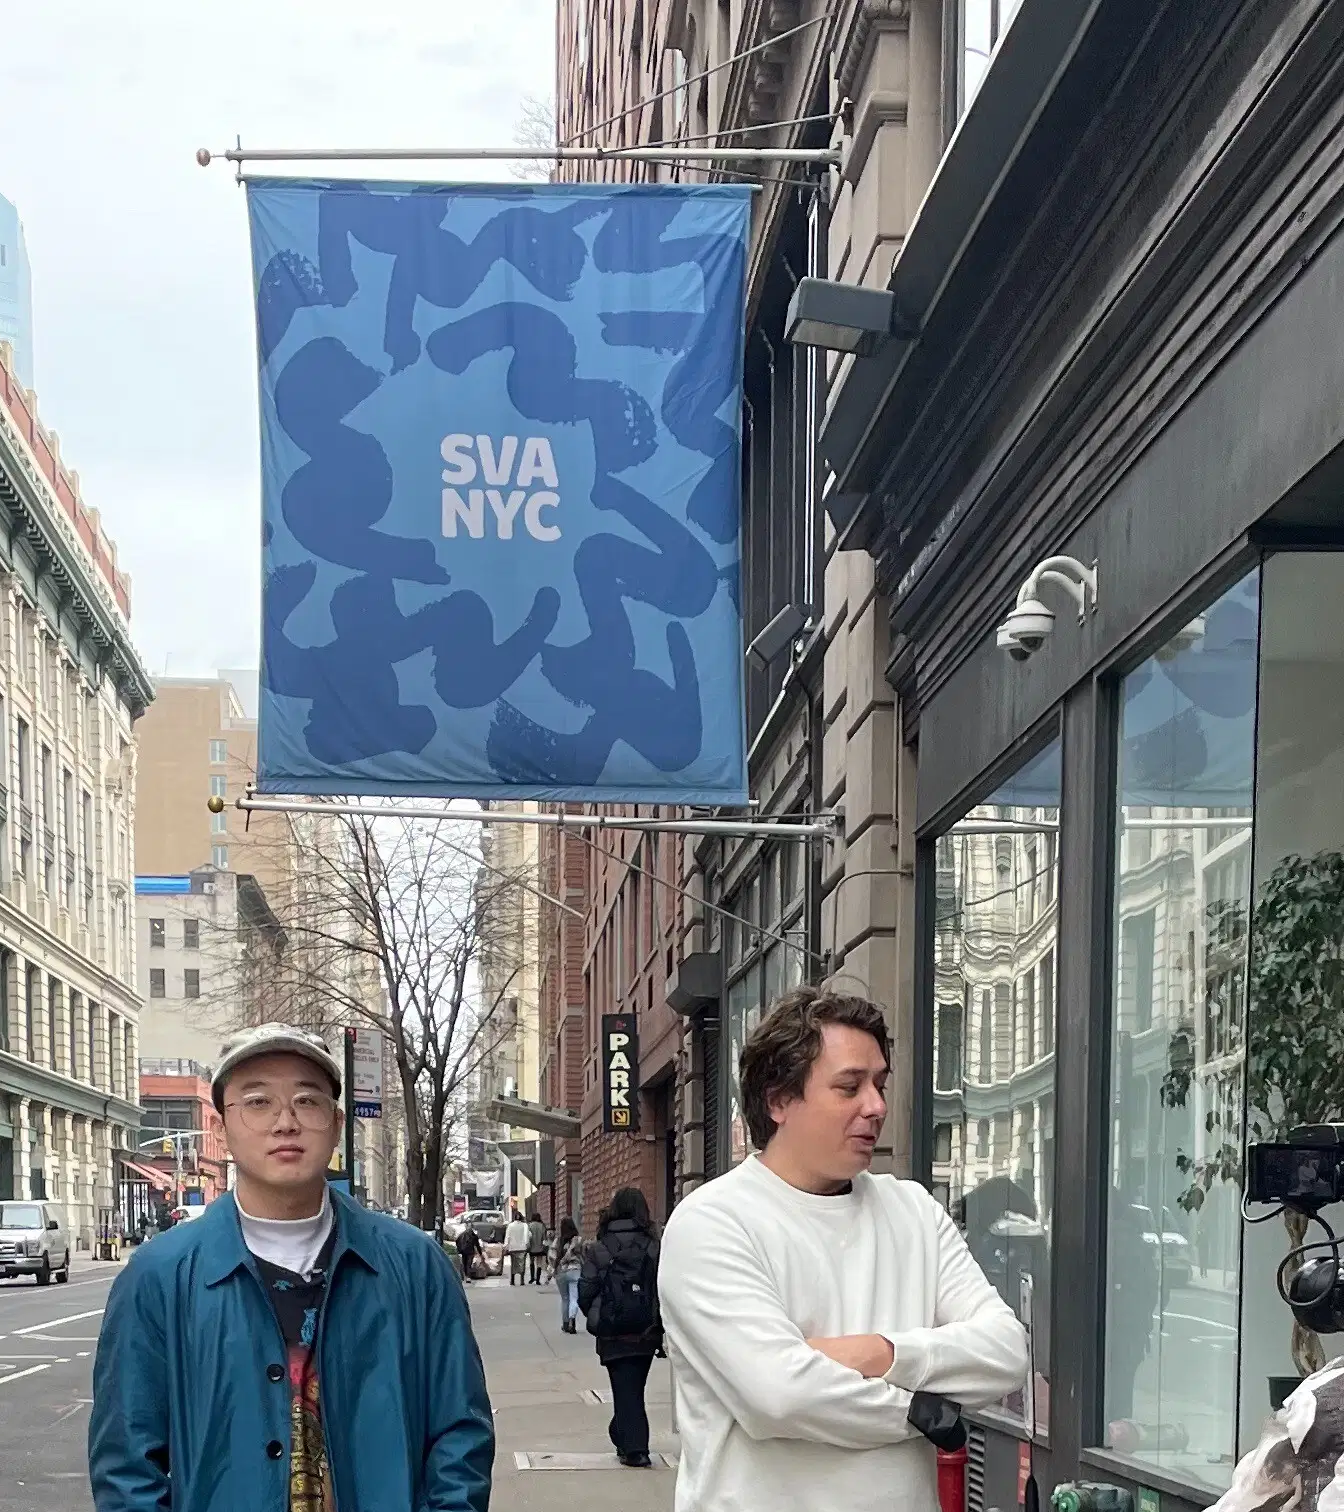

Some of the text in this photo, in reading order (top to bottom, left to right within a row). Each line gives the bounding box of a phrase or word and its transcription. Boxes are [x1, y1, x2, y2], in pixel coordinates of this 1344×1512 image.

[440, 433, 559, 487] SVA
[441, 488, 562, 542] NYC
[609, 1033, 631, 1107] PARK
